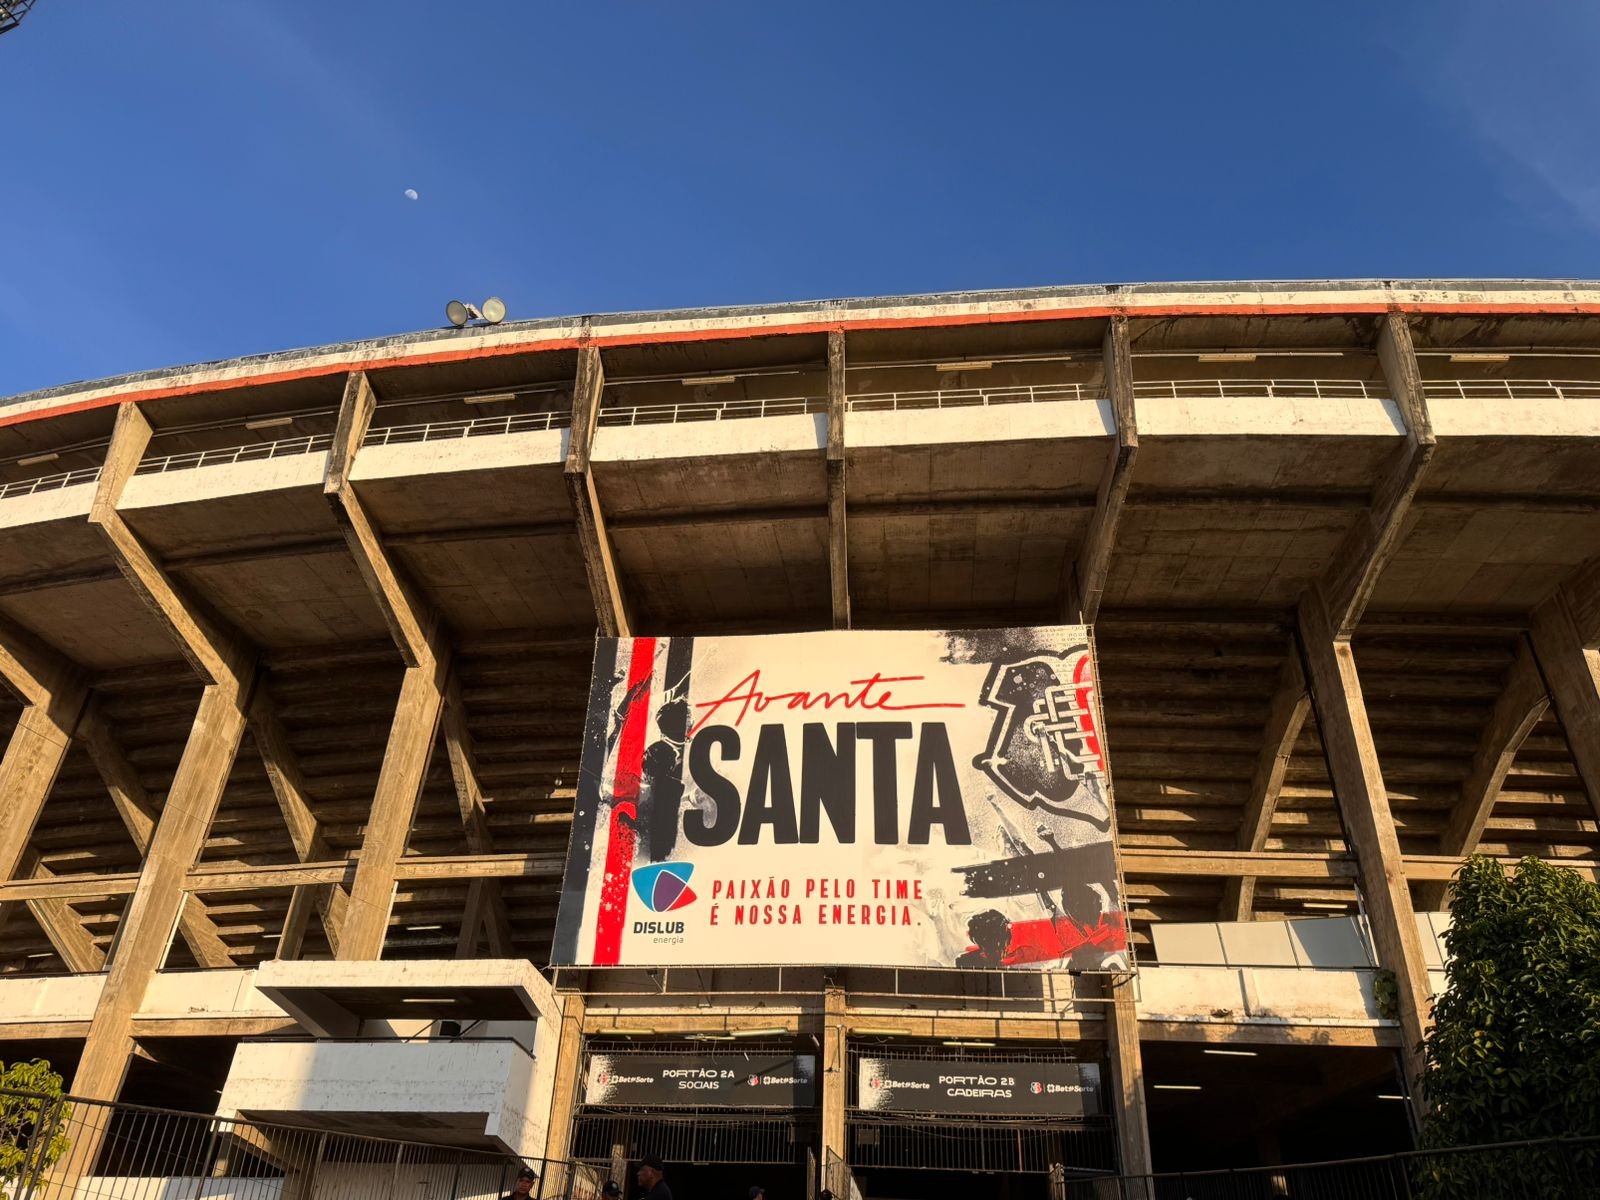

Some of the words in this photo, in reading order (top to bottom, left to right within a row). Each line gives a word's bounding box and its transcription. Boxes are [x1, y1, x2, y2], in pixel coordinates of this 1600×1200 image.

[689, 669, 966, 739] Avante
[684, 721, 972, 847] SANTA
[712, 876, 791, 901] PAIXÃO
[805, 878, 856, 900] PELO
[872, 879, 922, 901] TIME
[709, 902, 719, 927] É
[734, 904, 803, 926] NOSSA
[818, 904, 922, 926] ENERGIA.
[633, 921, 685, 934] DISLUB
[653, 935, 684, 945] energia
[662, 1068, 718, 1079] PORTÃO
[720, 1070, 735, 1079] 2A
[678, 1080, 720, 1090] SOCIAIS
[938, 1074, 998, 1086] PORTÃO
[1000, 1077, 1016, 1087] 2B
[946, 1087, 1013, 1099] CADEIRAS
